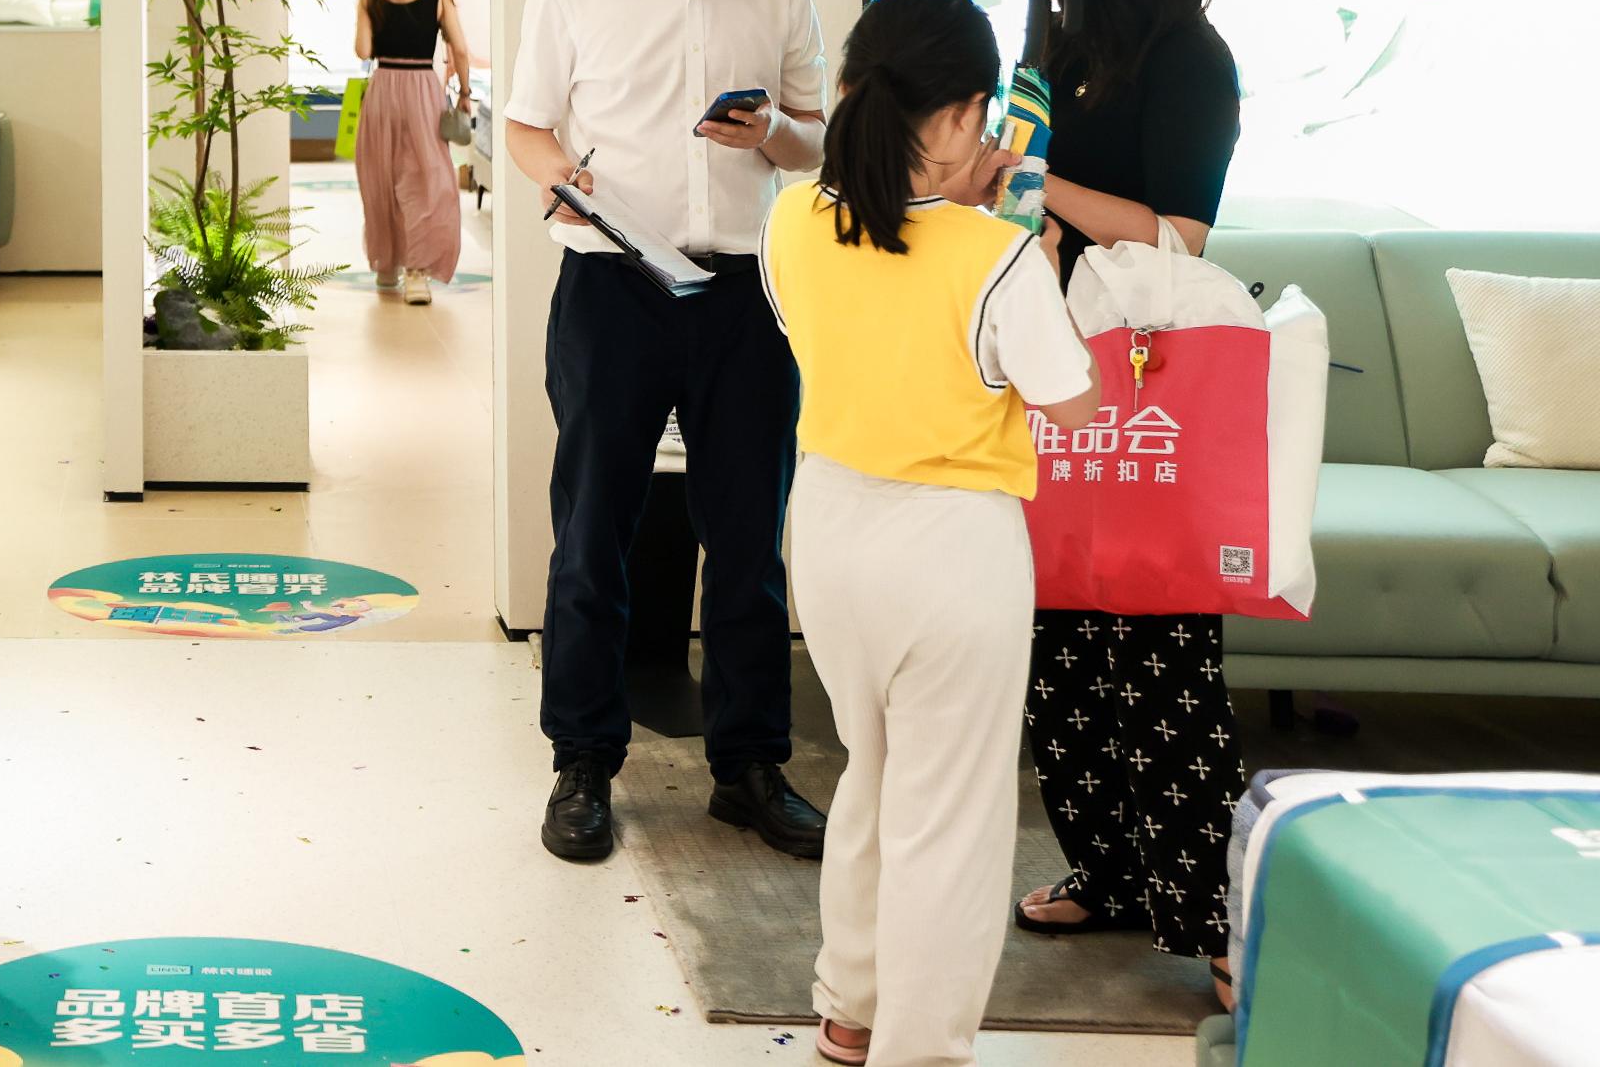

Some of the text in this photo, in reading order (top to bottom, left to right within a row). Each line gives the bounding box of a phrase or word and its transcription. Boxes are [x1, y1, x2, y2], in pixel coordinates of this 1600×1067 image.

[1051, 459, 1178, 484] 牌折扣店
[138, 571, 327, 584] 林氏睡眠
[55, 989, 365, 1022] 品牌首店
[50, 1018, 368, 1054] 多买多省
